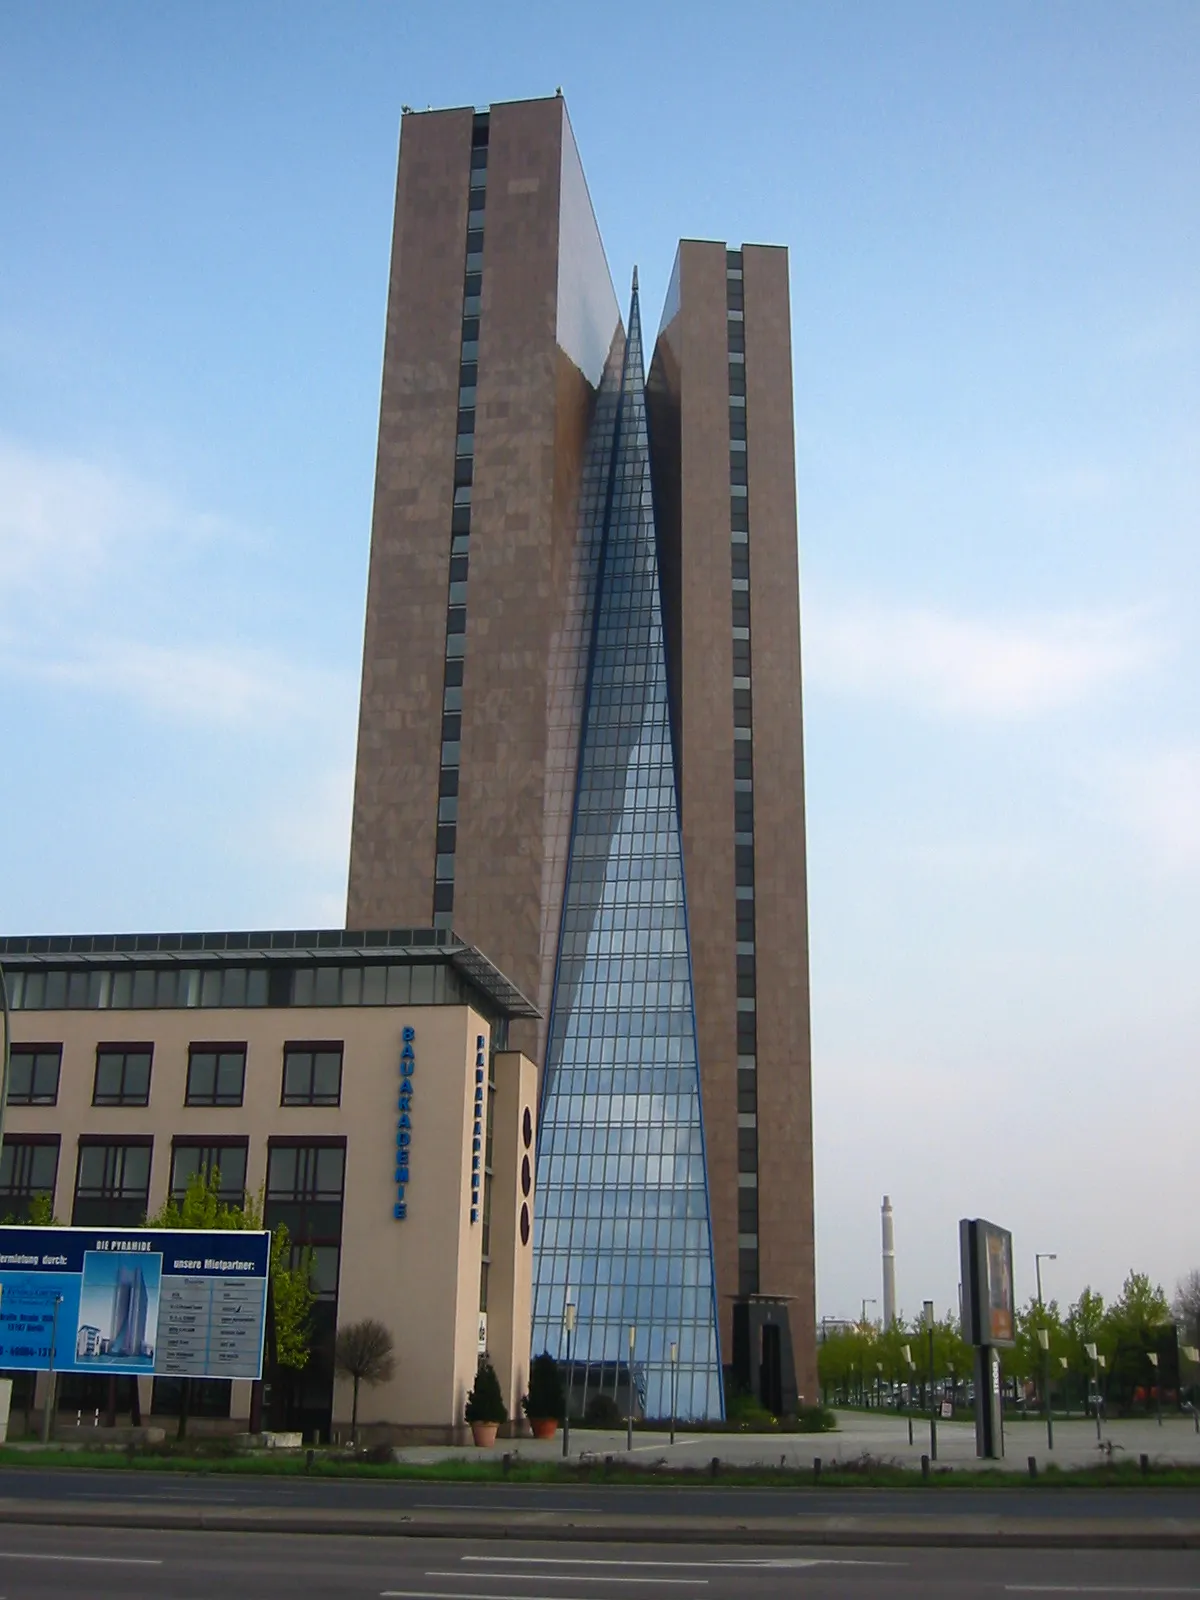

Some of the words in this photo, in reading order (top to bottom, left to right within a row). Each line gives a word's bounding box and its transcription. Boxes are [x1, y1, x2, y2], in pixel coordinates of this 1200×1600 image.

[393, 1026, 415, 1220] BAUAKADEMIE
[96, 1240, 109, 1250] DIE
[111, 1240, 152, 1252] PYRAMIDE
[0, 1253, 39, 1266] ermietung
[173, 1259, 202, 1269] unsere
[204, 1258, 255, 1270] Mietpartner:
